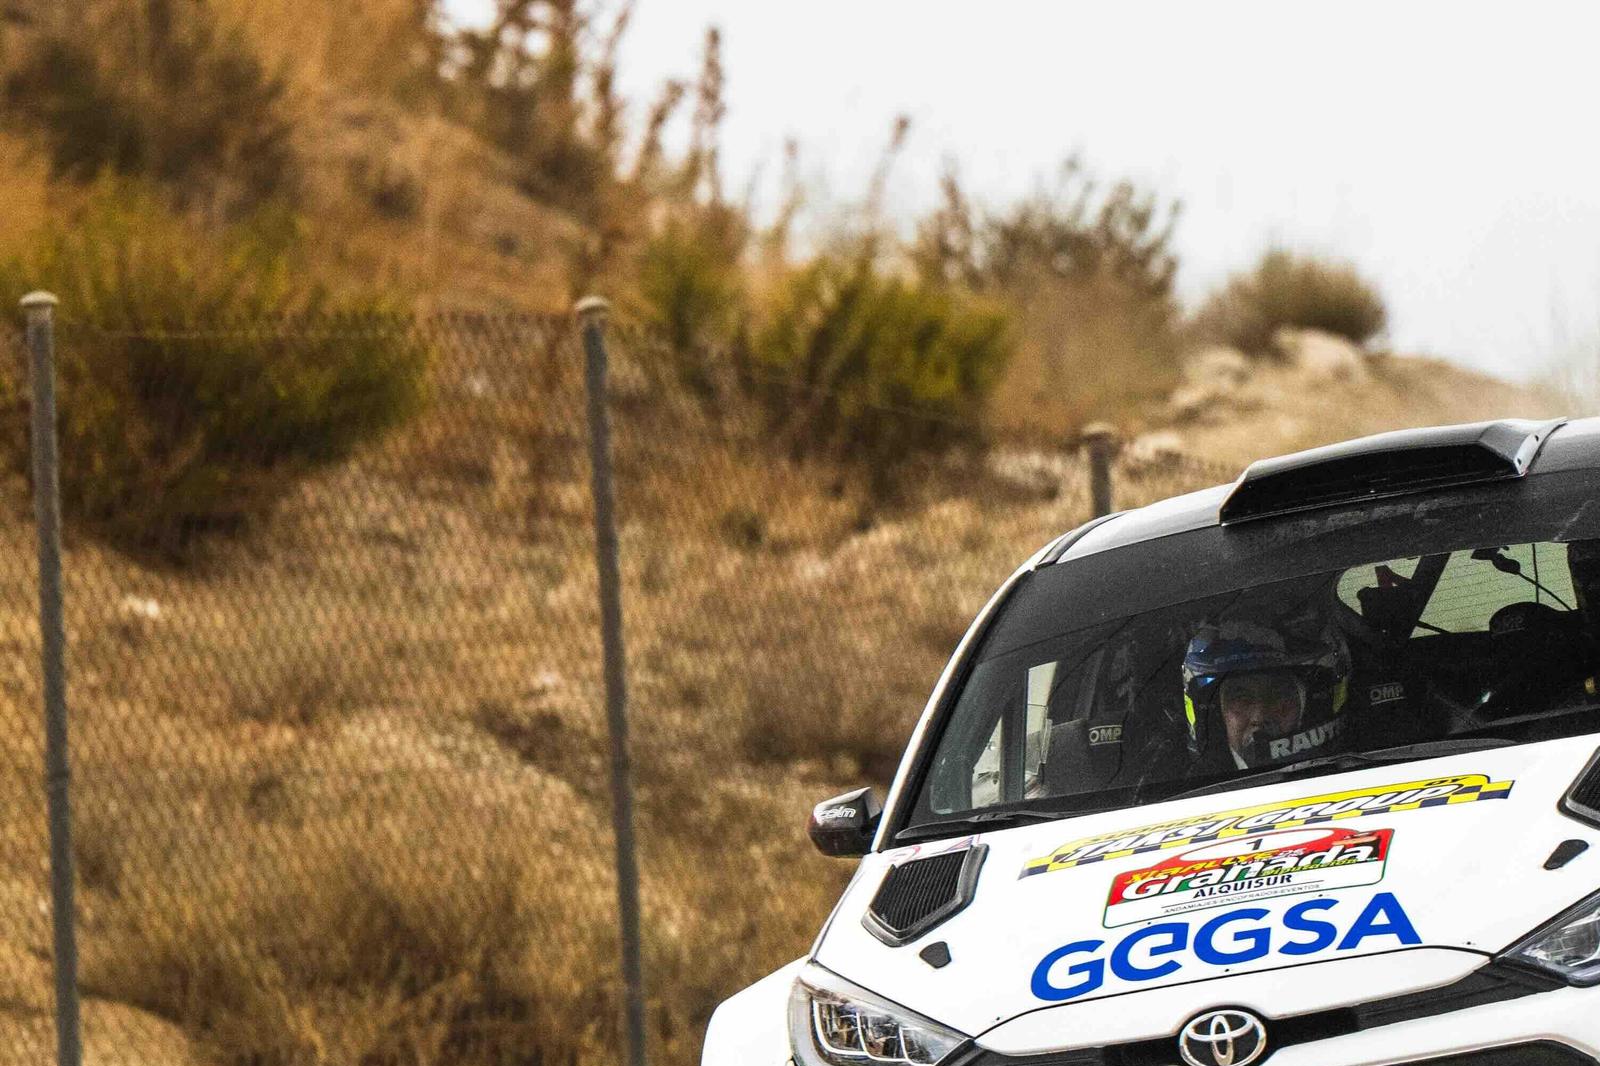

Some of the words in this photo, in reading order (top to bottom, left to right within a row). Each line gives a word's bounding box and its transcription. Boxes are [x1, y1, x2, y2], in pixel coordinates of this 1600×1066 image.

[1089, 727, 1122, 743] OMP
[1062, 816, 1245, 863] TAKSI
[1235, 784, 1463, 829] GROUP
[1246, 838, 1263, 851] 1
[1121, 844, 1374, 900] Granada
[1193, 874, 1292, 899] ALQUISUR
